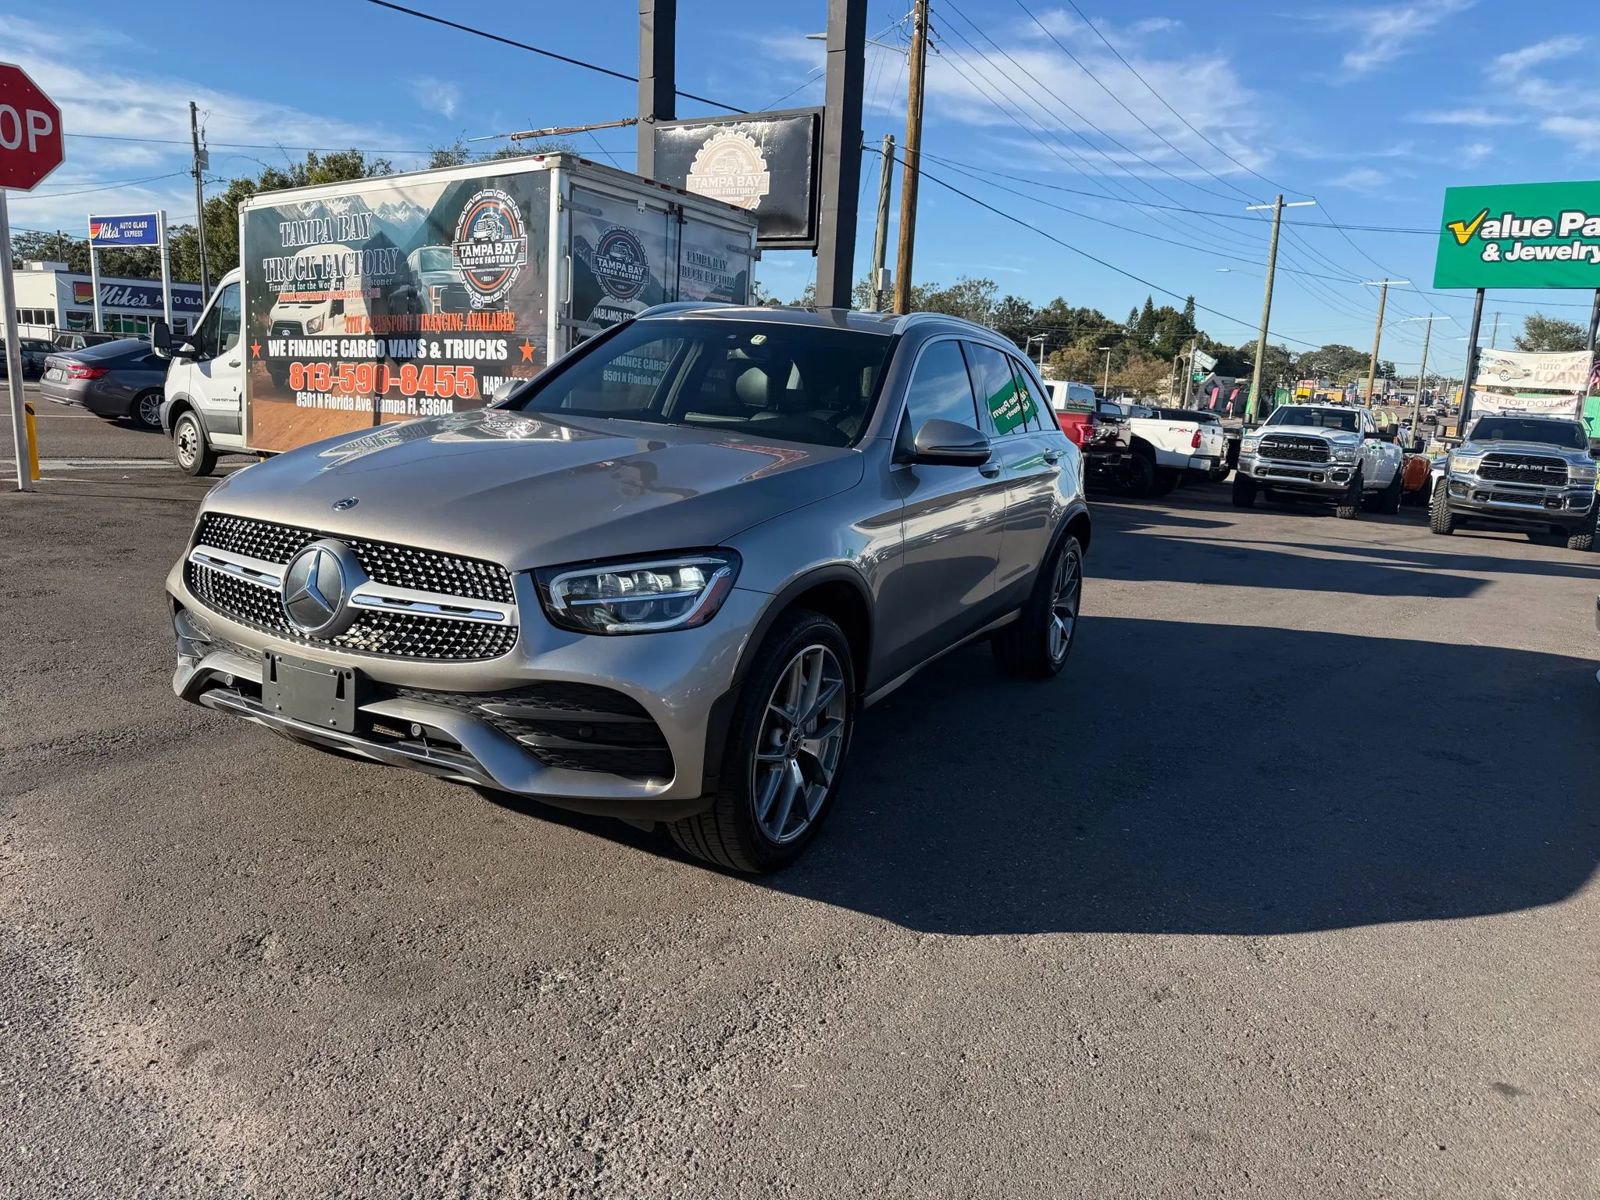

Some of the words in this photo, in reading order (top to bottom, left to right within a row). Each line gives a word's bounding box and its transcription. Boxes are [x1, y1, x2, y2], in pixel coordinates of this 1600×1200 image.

[695, 177, 734, 188] TAMPA
[737, 175, 761, 187] BAY
[98, 222, 120, 240] Mike's
[120, 221, 132, 229] AUTO
[132, 221, 148, 229] GLASS
[124, 230, 143, 238] EXPRESS
[280, 217, 334, 247] TAMPA
[338, 211, 373, 242] BAY
[460, 244, 494, 257] TAMPA
[495, 242, 519, 255] BAY
[1482, 243, 1500, 261] &
[1505, 242, 1600, 263] Jewelry
[263, 254, 318, 283] TRUCK
[320, 247, 400, 280] FACTORY
[462, 257, 484, 265] TRUCK
[485, 255, 515, 264] FACTORY
[597, 257, 627, 272] TAMPA
[628, 264, 644, 276] BAY
[99, 285, 150, 307] Mike's
[156, 295, 182, 304] AO
[414, 313, 463, 332] FINANCING
[465, 311, 515, 333] AVAILABLE
[593, 307, 622, 322] HABLAMOS
[268, 339, 287, 357] WE
[288, 339, 338, 357] FINANCE
[340, 339, 385, 358] CARGO
[388, 338, 427, 359] VANS
[429, 341, 442, 359] &
[444, 339, 508, 360] TRUCKS
[289, 361, 476, 399] 813-590-8455
[603, 370, 620, 382] 8501
[628, 371, 651, 386] Florida
[296, 392, 316, 408] 8501
[317, 394, 324, 408] N
[324, 393, 353, 411] Florida
[355, 395, 374, 412] Ave.
[374, 397, 406, 415] Tampa
[419, 398, 454, 416] 33604
[1481, 395, 1502, 405] GET
[1504, 397, 1524, 407] TOP
[1527, 399, 1571, 408] DOLLAR
[1504, 463, 1543, 471] RAM
